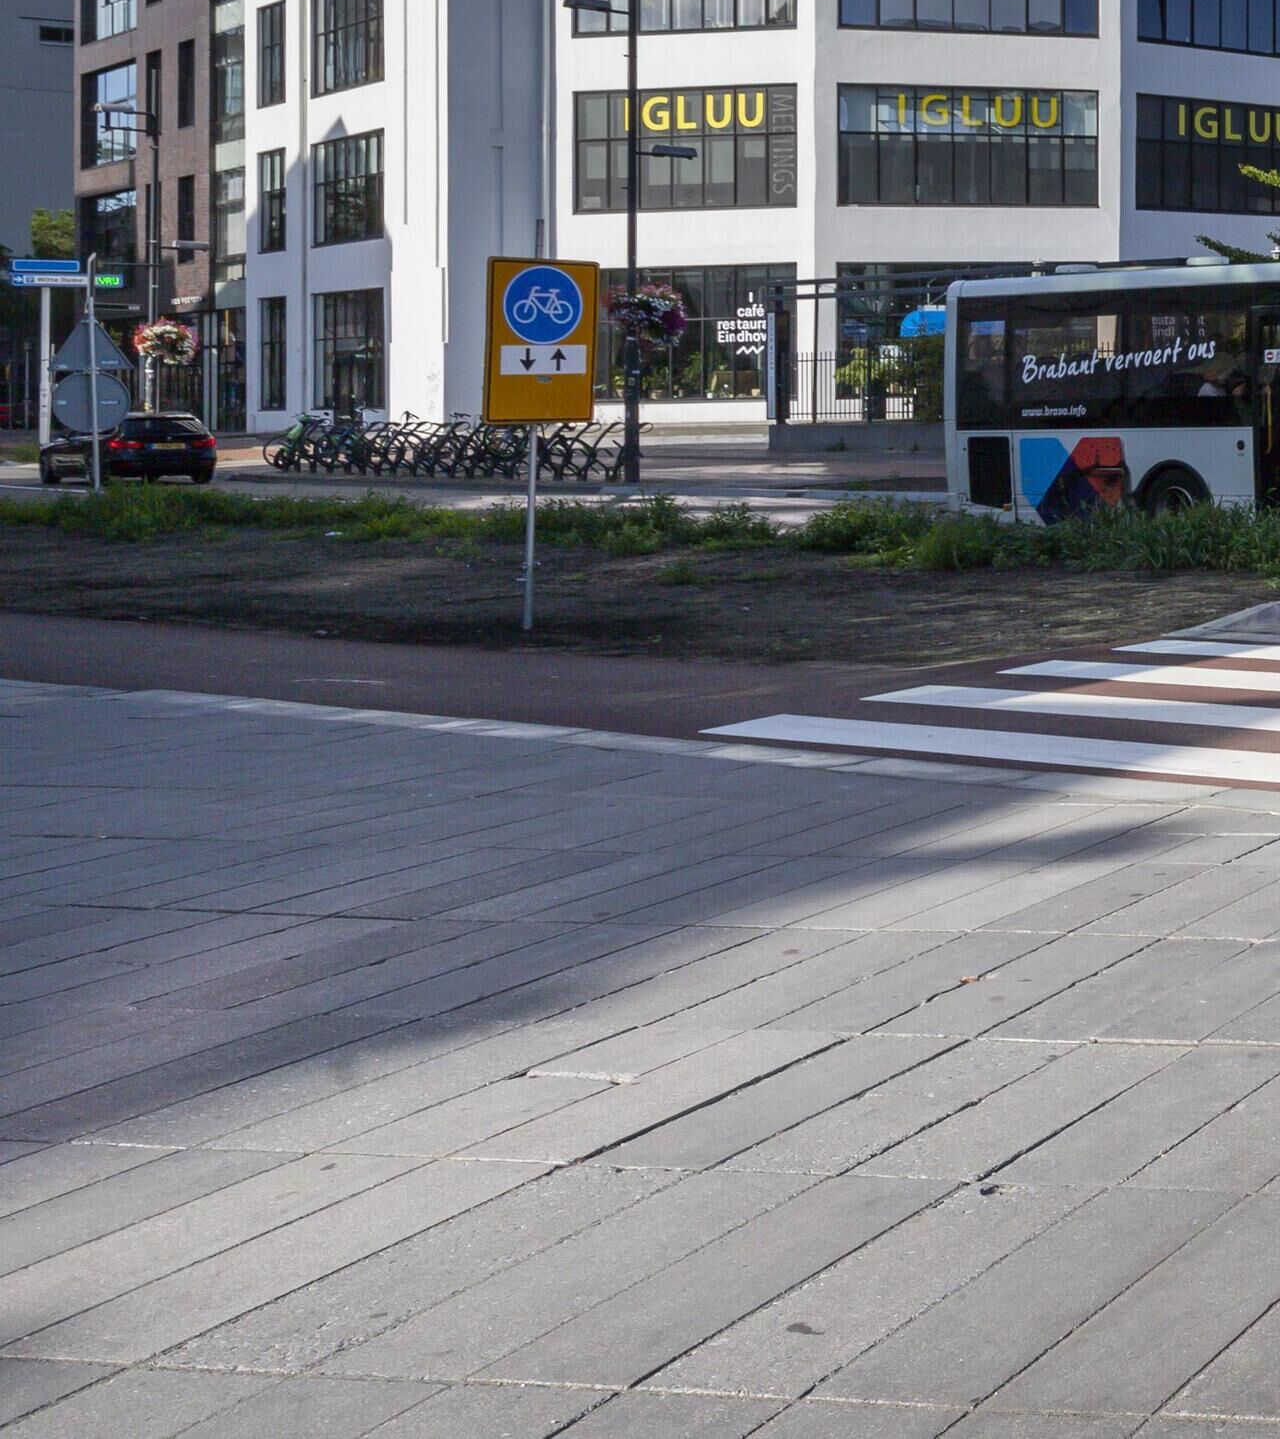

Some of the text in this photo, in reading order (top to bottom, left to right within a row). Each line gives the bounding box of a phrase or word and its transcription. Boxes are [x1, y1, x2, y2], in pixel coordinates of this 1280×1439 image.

[624, 92, 765, 132] IGLUU
[897, 93, 1058, 128] IGLUU
[771, 93, 795, 195] MEETINGS
[736, 303, 765, 318] café
[1022, 336, 1216, 384] Brabant vervoert ons
[1021, 404, 1087, 418] www.bravo.info
